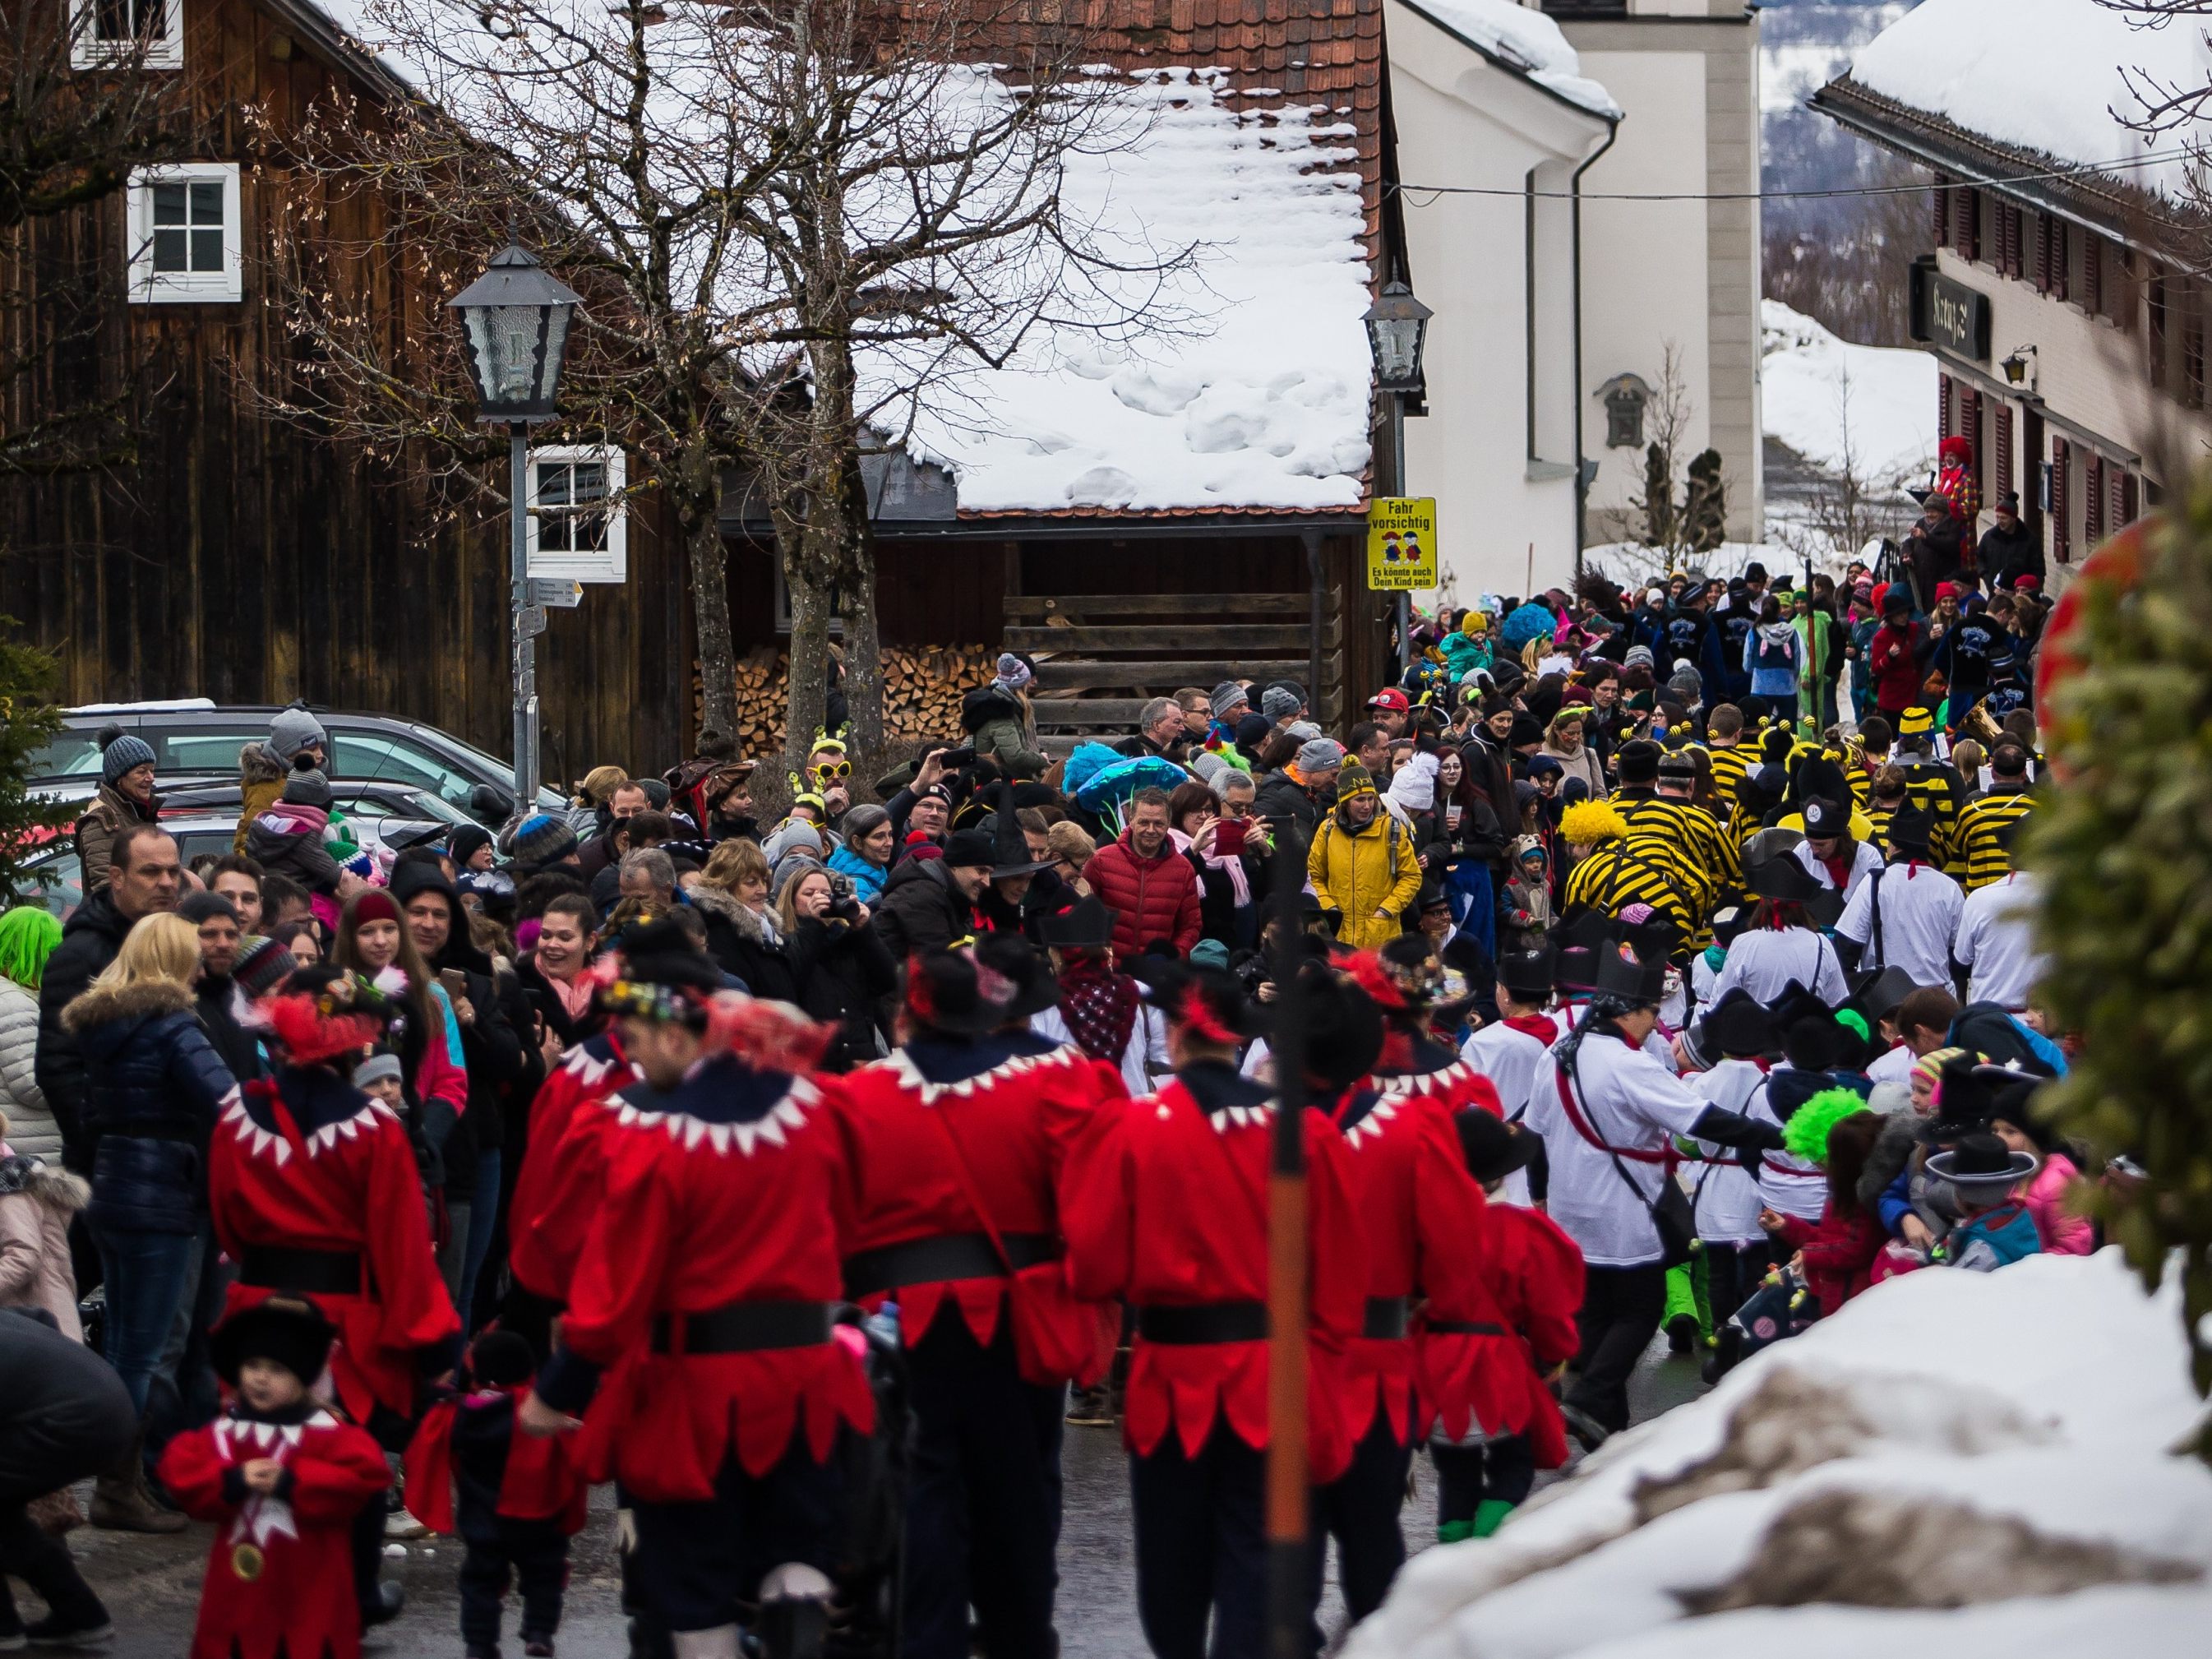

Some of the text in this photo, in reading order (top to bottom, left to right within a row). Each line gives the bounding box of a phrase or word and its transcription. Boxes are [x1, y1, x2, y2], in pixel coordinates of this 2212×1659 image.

[1388, 501, 1414, 515] Fahr
[1372, 515, 1430, 531] vorsichtig
[1373, 567, 1432, 577] Es könnte auch
[1374, 577, 1430, 586] Dein Kind sein
